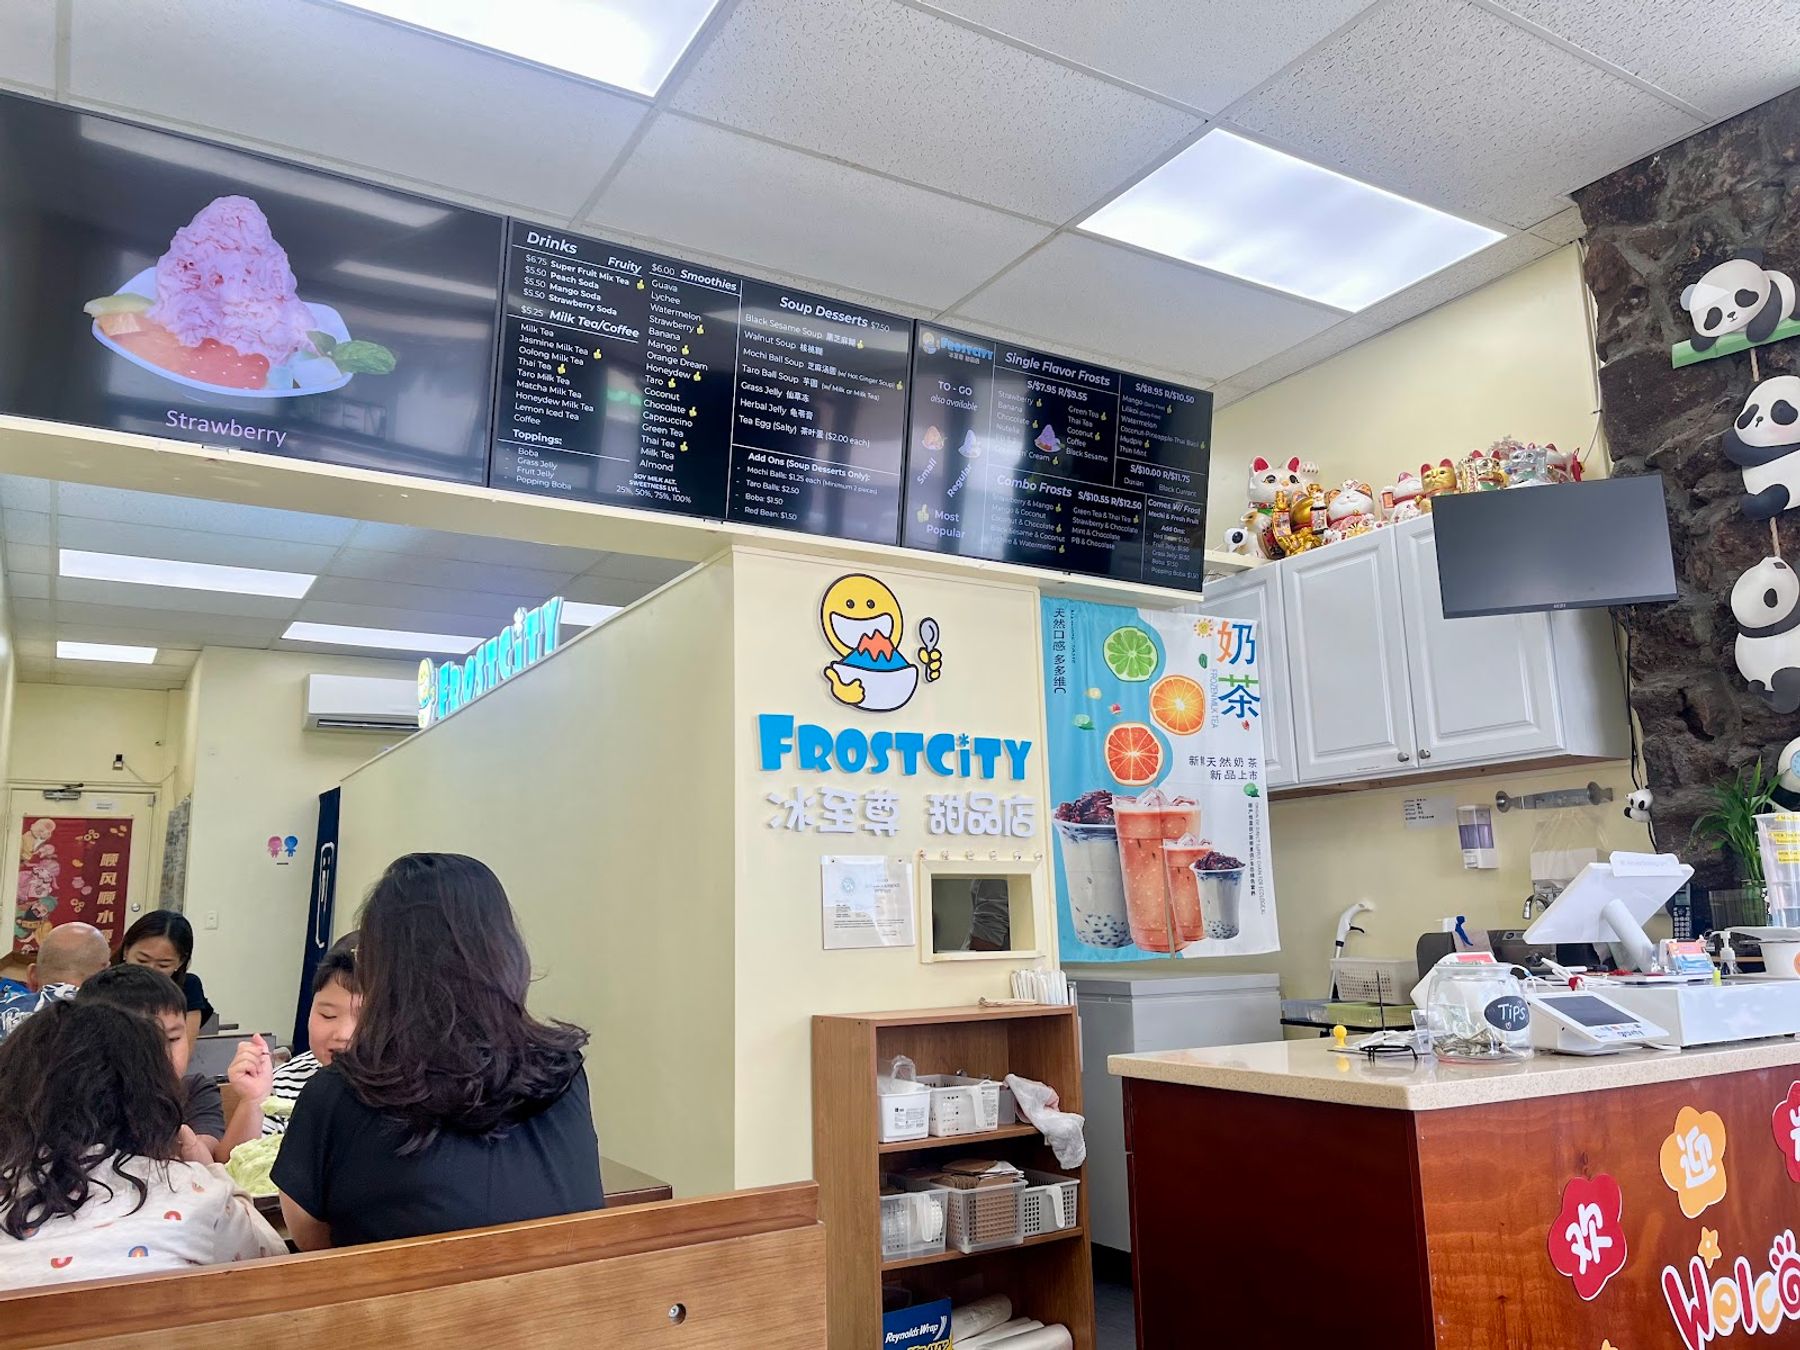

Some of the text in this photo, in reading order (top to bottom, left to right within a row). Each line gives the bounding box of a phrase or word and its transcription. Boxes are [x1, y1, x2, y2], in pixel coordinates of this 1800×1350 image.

[527, 232, 577, 254] Drinks
[526, 254, 629, 286] $6.75 Super Fruit Mix Tea
[608, 257, 642, 274] Fruity
[525, 266, 599, 289] $5.50 Peach Soda
[652, 263, 736, 291] $6.00 Smoothies
[524, 277, 601, 301] $5.50 Mango Soda
[652, 280, 678, 292] Guava
[523, 288, 617, 316] $5.50 Strawberry Soda
[651, 292, 680, 305] Lychee
[650, 304, 701, 321] Watermelon
[780, 297, 812, 315] Soup
[815, 306, 868, 328] Desserts
[521, 305, 639, 338] $5.25 Milk Tea/Coffee
[649, 315, 694, 333] Strawberry
[745, 314, 823, 339] Black Sesame Soup
[521, 324, 554, 337] Milk Tea
[649, 327, 681, 341] Banana
[519, 335, 588, 355] Jasmine Milk Tea
[648, 339, 677, 353] Mango
[744, 330, 796, 350] Walnut Soup
[518, 357, 551, 371] Thai Tea
[519, 346, 584, 366] Oolong Milk Tea
[647, 351, 708, 371] Orange Dream
[743, 348, 804, 369] Mochi Ball Soup
[517, 368, 570, 385] Taro Milk Tea
[646, 363, 691, 380] Honeydew
[742, 364, 799, 385] Taro Ball Soup
[1005, 352, 1110, 386] Single Flavor Frosts
[645, 375, 664, 386] Taro
[938, 380, 972, 395] TO GO
[517, 380, 582, 399] Matcha Milk Tea
[644, 387, 680, 401] Coconut
[741, 382, 783, 398] Grass Jelly
[1027, 380, 1088, 401] S/$7.95 R/$9.55
[1135, 383, 1194, 403] S/$8.95 R/$10.50
[516, 392, 594, 412] Honeydew Milk Tea
[644, 399, 686, 414] Chocolate
[740, 398, 787, 416] Herbal Jelly
[930, 394, 978, 411] also available
[514, 414, 541, 426] Coffee
[515, 403, 579, 421] Lemon Iced Tea
[643, 412, 693, 428] Cappuccino
[166, 410, 287, 447] Strawberry
[512, 429, 563, 445] Toppings:
[642, 423, 684, 438] Green Tea
[739, 415, 753, 425] Tea
[755, 419, 771, 430] Egg
[773, 422, 797, 435] (Salty)
[825, 431, 848, 443] ($2.00
[850, 437, 870, 448] each)
[1067, 427, 1093, 438] Coconut
[642, 435, 675, 448] Thai Tea
[1066, 437, 1086, 447] Coffee
[518, 448, 539, 457] Boba
[640, 448, 674, 460] Milk Tea
[518, 458, 557, 471] Grass Jelly
[639, 460, 673, 472] Almond
[748, 452, 766, 462] Add
[768, 456, 785, 466] Ons
[786, 459, 809, 471] (Soup
[811, 463, 846, 478] Desserts
[916, 457, 937, 485] Small
[516, 476, 572, 491] Popping Boba
[746, 479, 761, 488] Taro
[782, 485, 799, 495] $2.50
[947, 463, 973, 498] Regular
[997, 475, 1142, 509] Combo Frosts S/$10.55 R/$12.50
[745, 506, 759, 515] Red
[781, 511, 797, 520] $1.50
[1148, 499, 1171, 510] Comes
[1184, 504, 1201, 515] Frost
[934, 510, 959, 522] Most
[926, 525, 965, 539] Popular
[1217, 620, 1261, 719] 奶茶
[1210, 770, 1258, 780] 新品上市
[766, 786, 1036, 838] 冰至尊 甜品店
[1566, 1202, 1613, 1275] 欢
[1677, 1126, 1716, 1188] 迎
[885, 1322, 939, 1344] Reynolds Wrap
